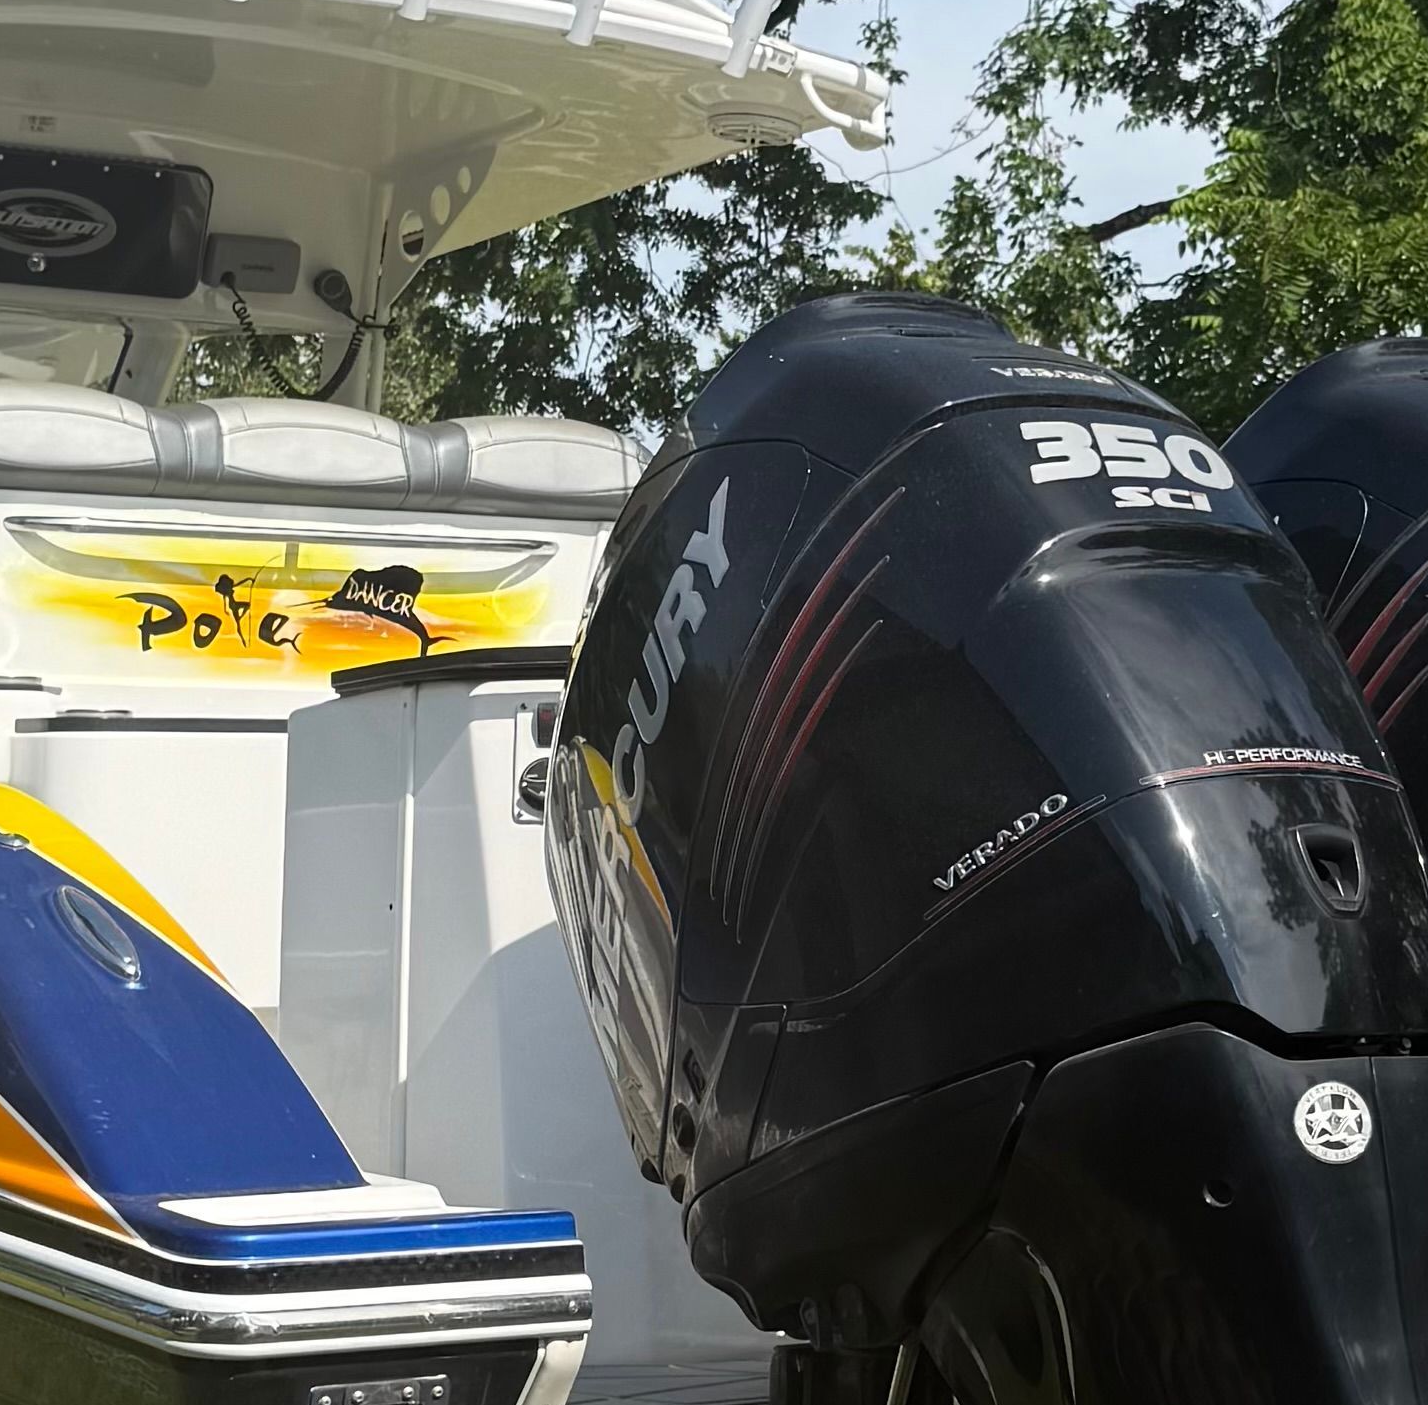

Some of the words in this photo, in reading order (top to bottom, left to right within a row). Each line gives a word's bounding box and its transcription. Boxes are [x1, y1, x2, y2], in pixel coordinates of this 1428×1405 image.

[1019, 420, 1235, 491] 350
[344, 577, 414, 618] DANCER
[590, 475, 730, 1080] MERCURY
[932, 793, 1068, 891] VERADO
